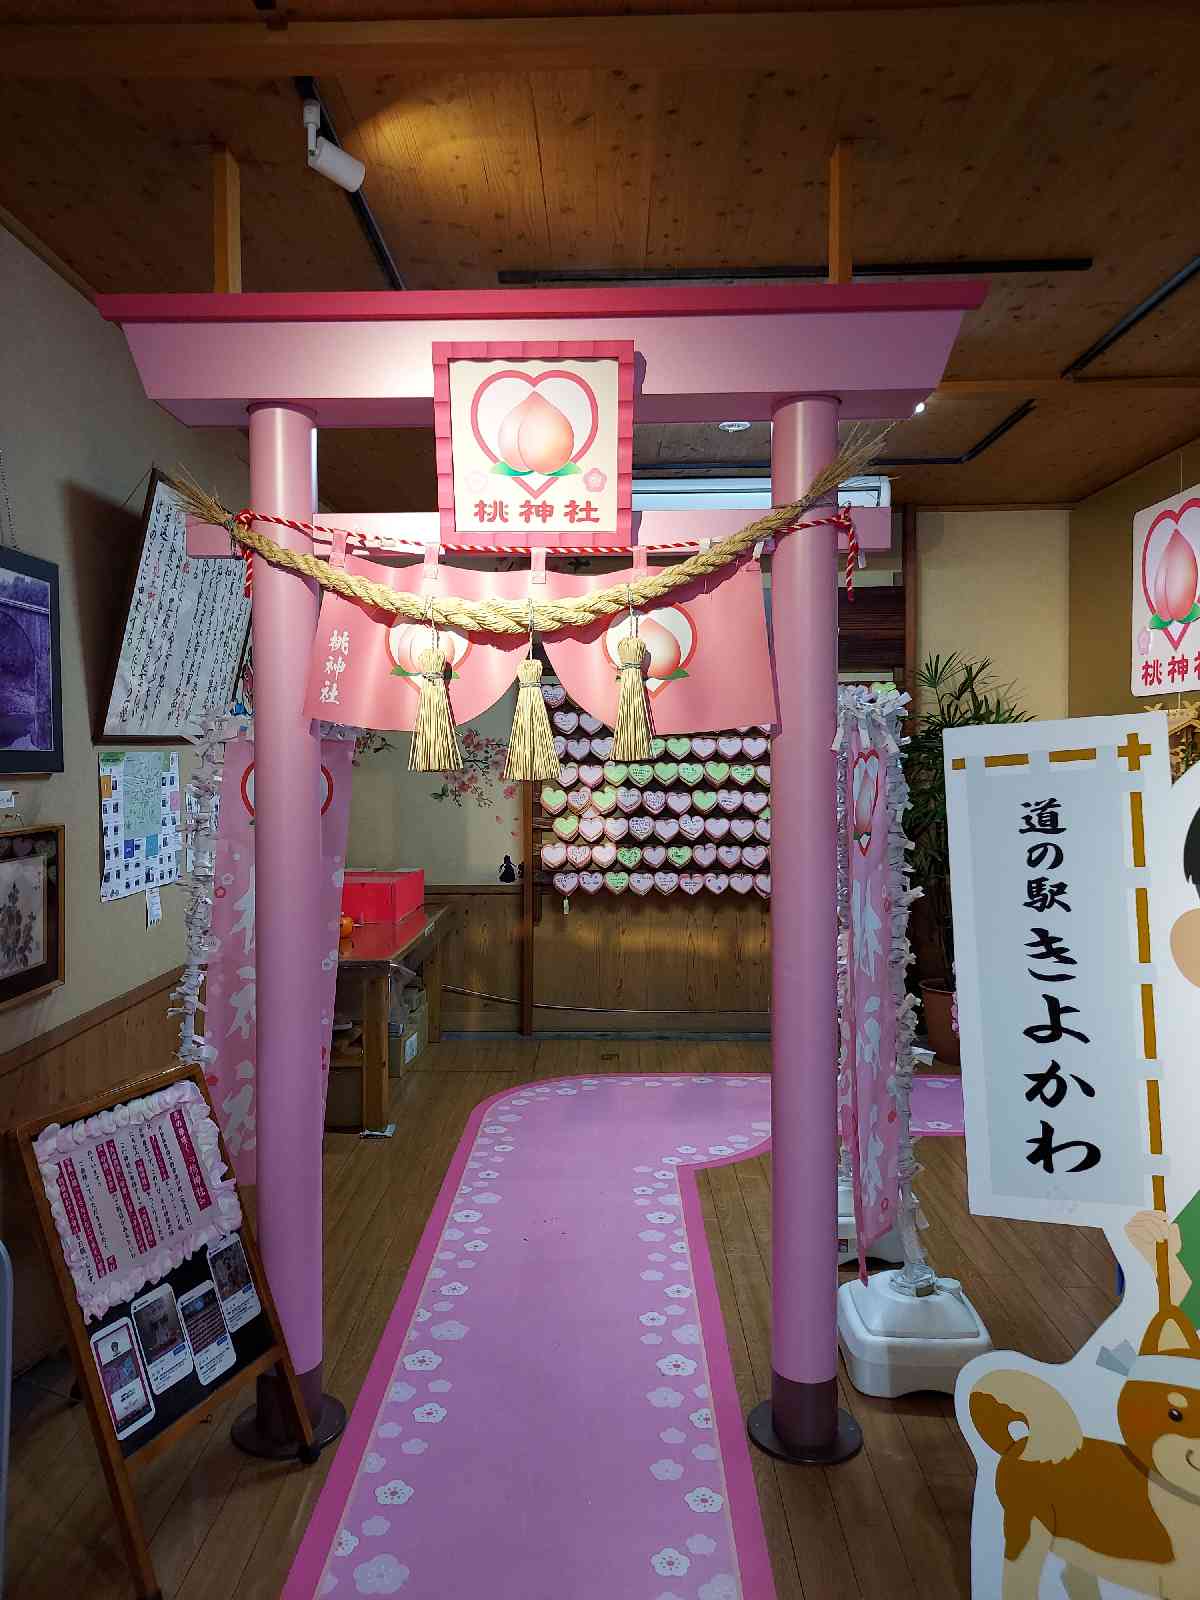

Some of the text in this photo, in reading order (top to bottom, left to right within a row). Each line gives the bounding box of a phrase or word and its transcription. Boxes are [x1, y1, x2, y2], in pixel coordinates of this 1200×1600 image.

[474, 499, 600, 524] 桃神社
[1142, 650, 1200, 687] 桃神
[1018, 797, 1101, 1173] 道の駅きよかわ
